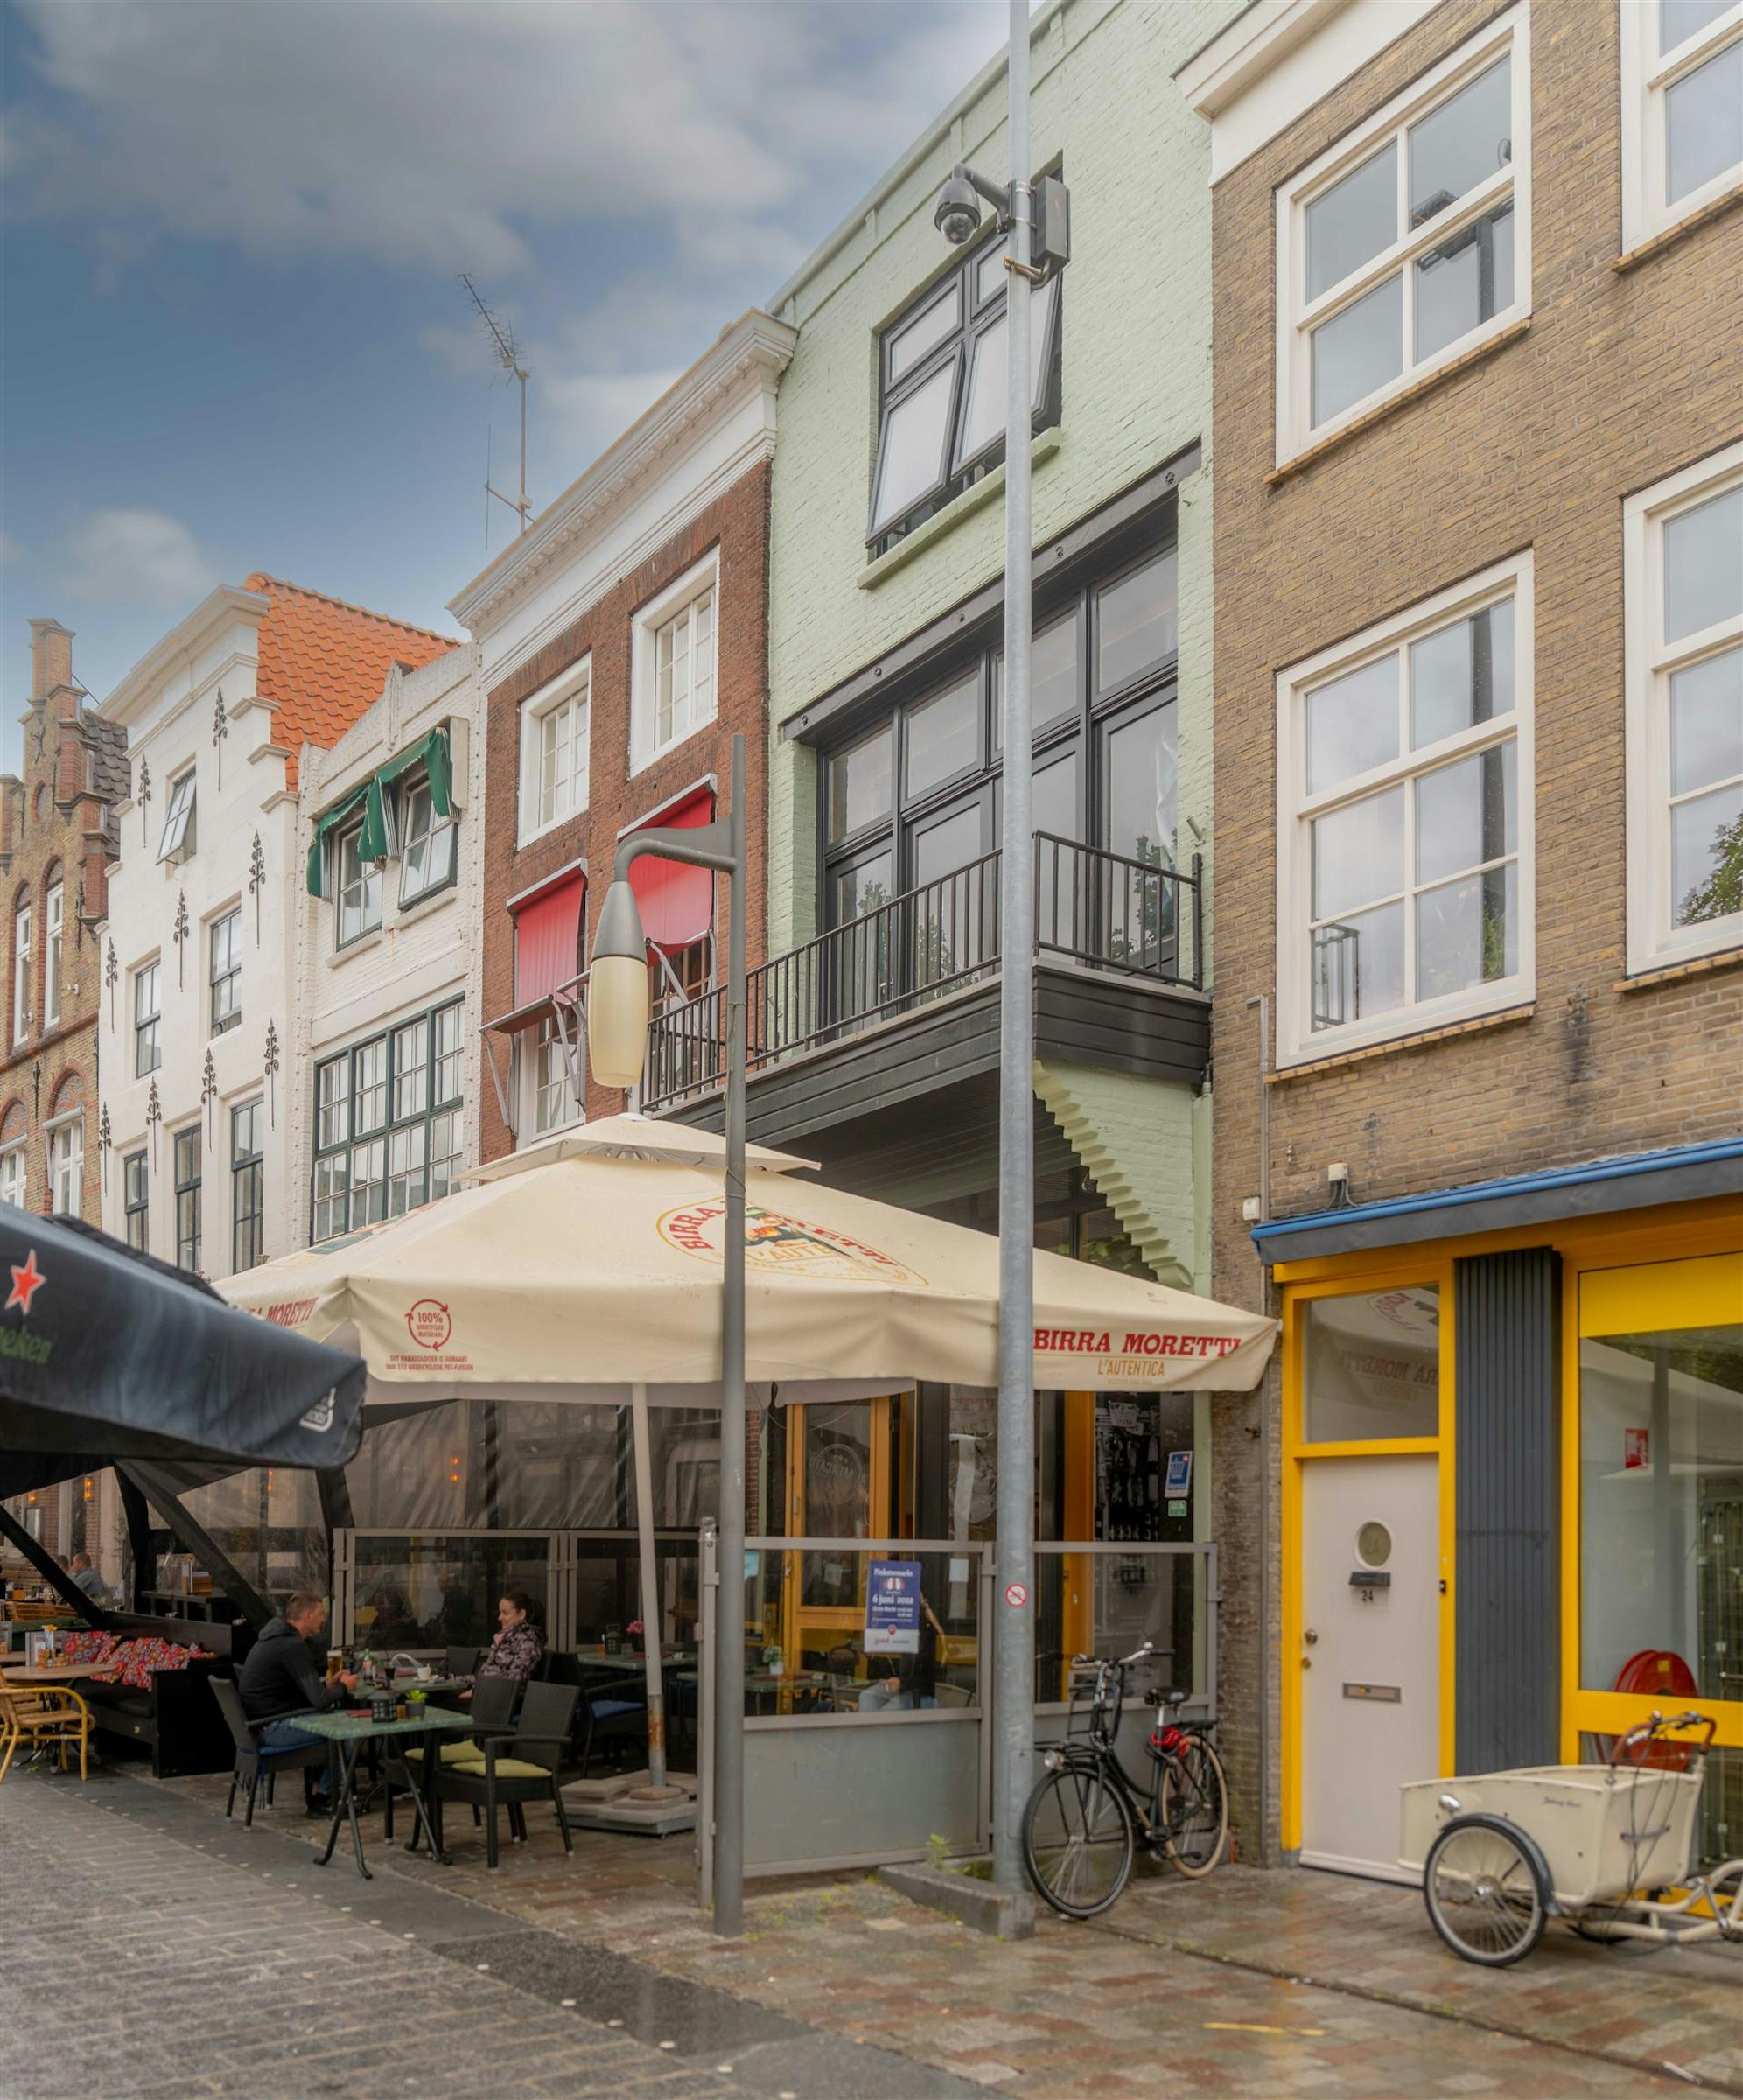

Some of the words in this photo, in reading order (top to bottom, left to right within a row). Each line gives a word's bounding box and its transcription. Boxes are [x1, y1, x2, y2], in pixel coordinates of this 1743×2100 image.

[669, 1204, 724, 1250] BIRRA
[417, 1312, 443, 1322] 100%
[1033, 1329, 1110, 1352] BIRRA
[1098, 1359, 1165, 1376] L'AUTENTICA
[872, 1593, 878, 1603] 6
[879, 1595, 894, 1605] juni
[1362, 1589, 1373, 1602] 24
